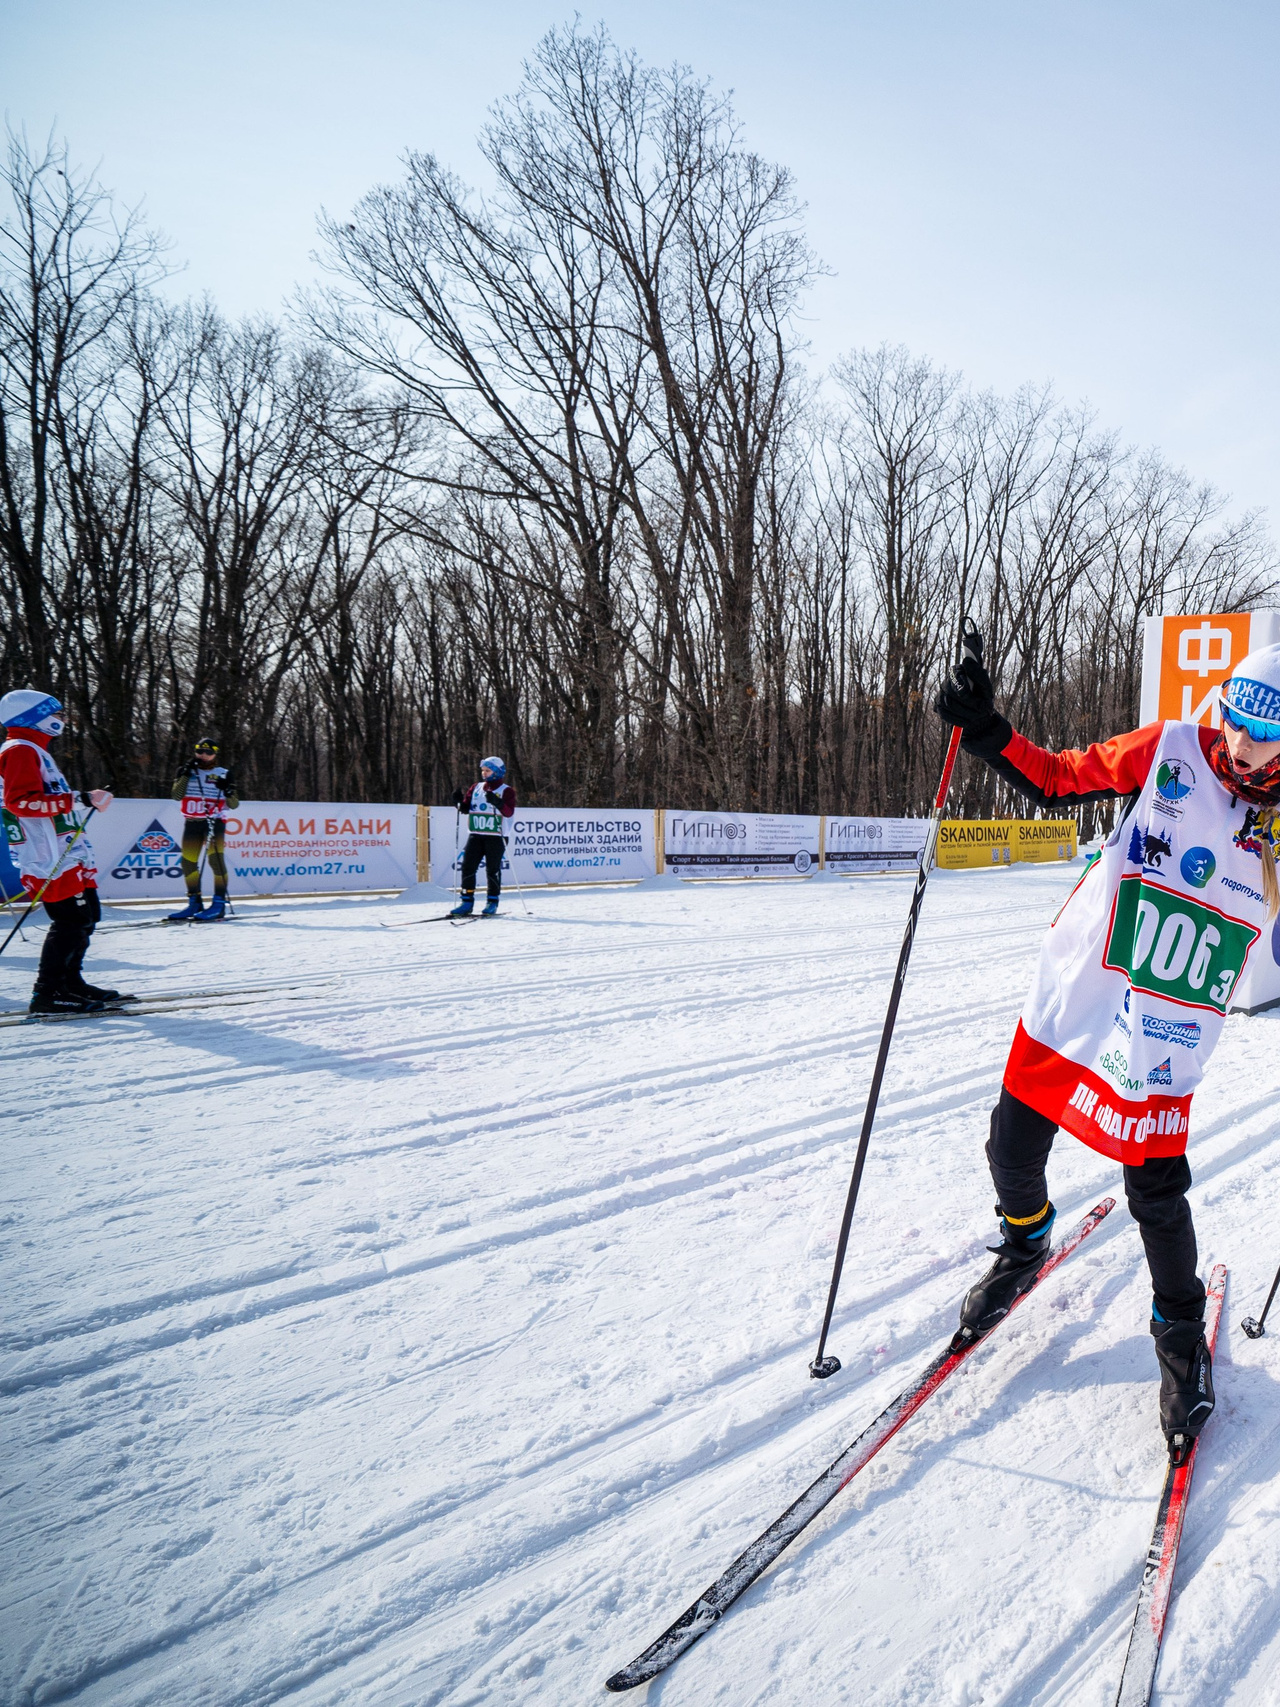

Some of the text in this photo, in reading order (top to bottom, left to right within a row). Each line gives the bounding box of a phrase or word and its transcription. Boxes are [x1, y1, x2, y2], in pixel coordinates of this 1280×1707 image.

[299, 818, 315, 835] И
[324, 819, 391, 835] БАНИ
[472, 816, 495, 830] 004
[513, 821, 641, 833] СТРОИТЕЛЬСТВО
[7, 824, 21, 841] 3
[514, 832, 642, 846] МОДУЛЬНЫХ ЗДАНИЙ
[940, 827, 1010, 843] SKANDINAV
[1019, 826, 1072, 840] SKANDINAV
[352, 839, 391, 847] БРЕВНА
[252, 850, 321, 858] КЛЕЕННОГО
[324, 849, 359, 857] БРУСА
[513, 847, 534, 856] ДЛЯ
[536, 846, 598, 855] СПОРТИВНЫХ
[600, 845, 643, 854] ОБЪЕКТОВ
[533, 856, 621, 869] www.dom27.ru
[672, 856, 691, 864] Спорт
[726, 855, 740, 863] Твой
[740, 855, 770, 863] идеальный
[234, 862, 365, 877] www.dom27.ru
[1131, 899, 1236, 1005] 006 3
[1114, 1049, 1128, 1072] ООО
[1069, 1081, 1100, 1118] ЛК
